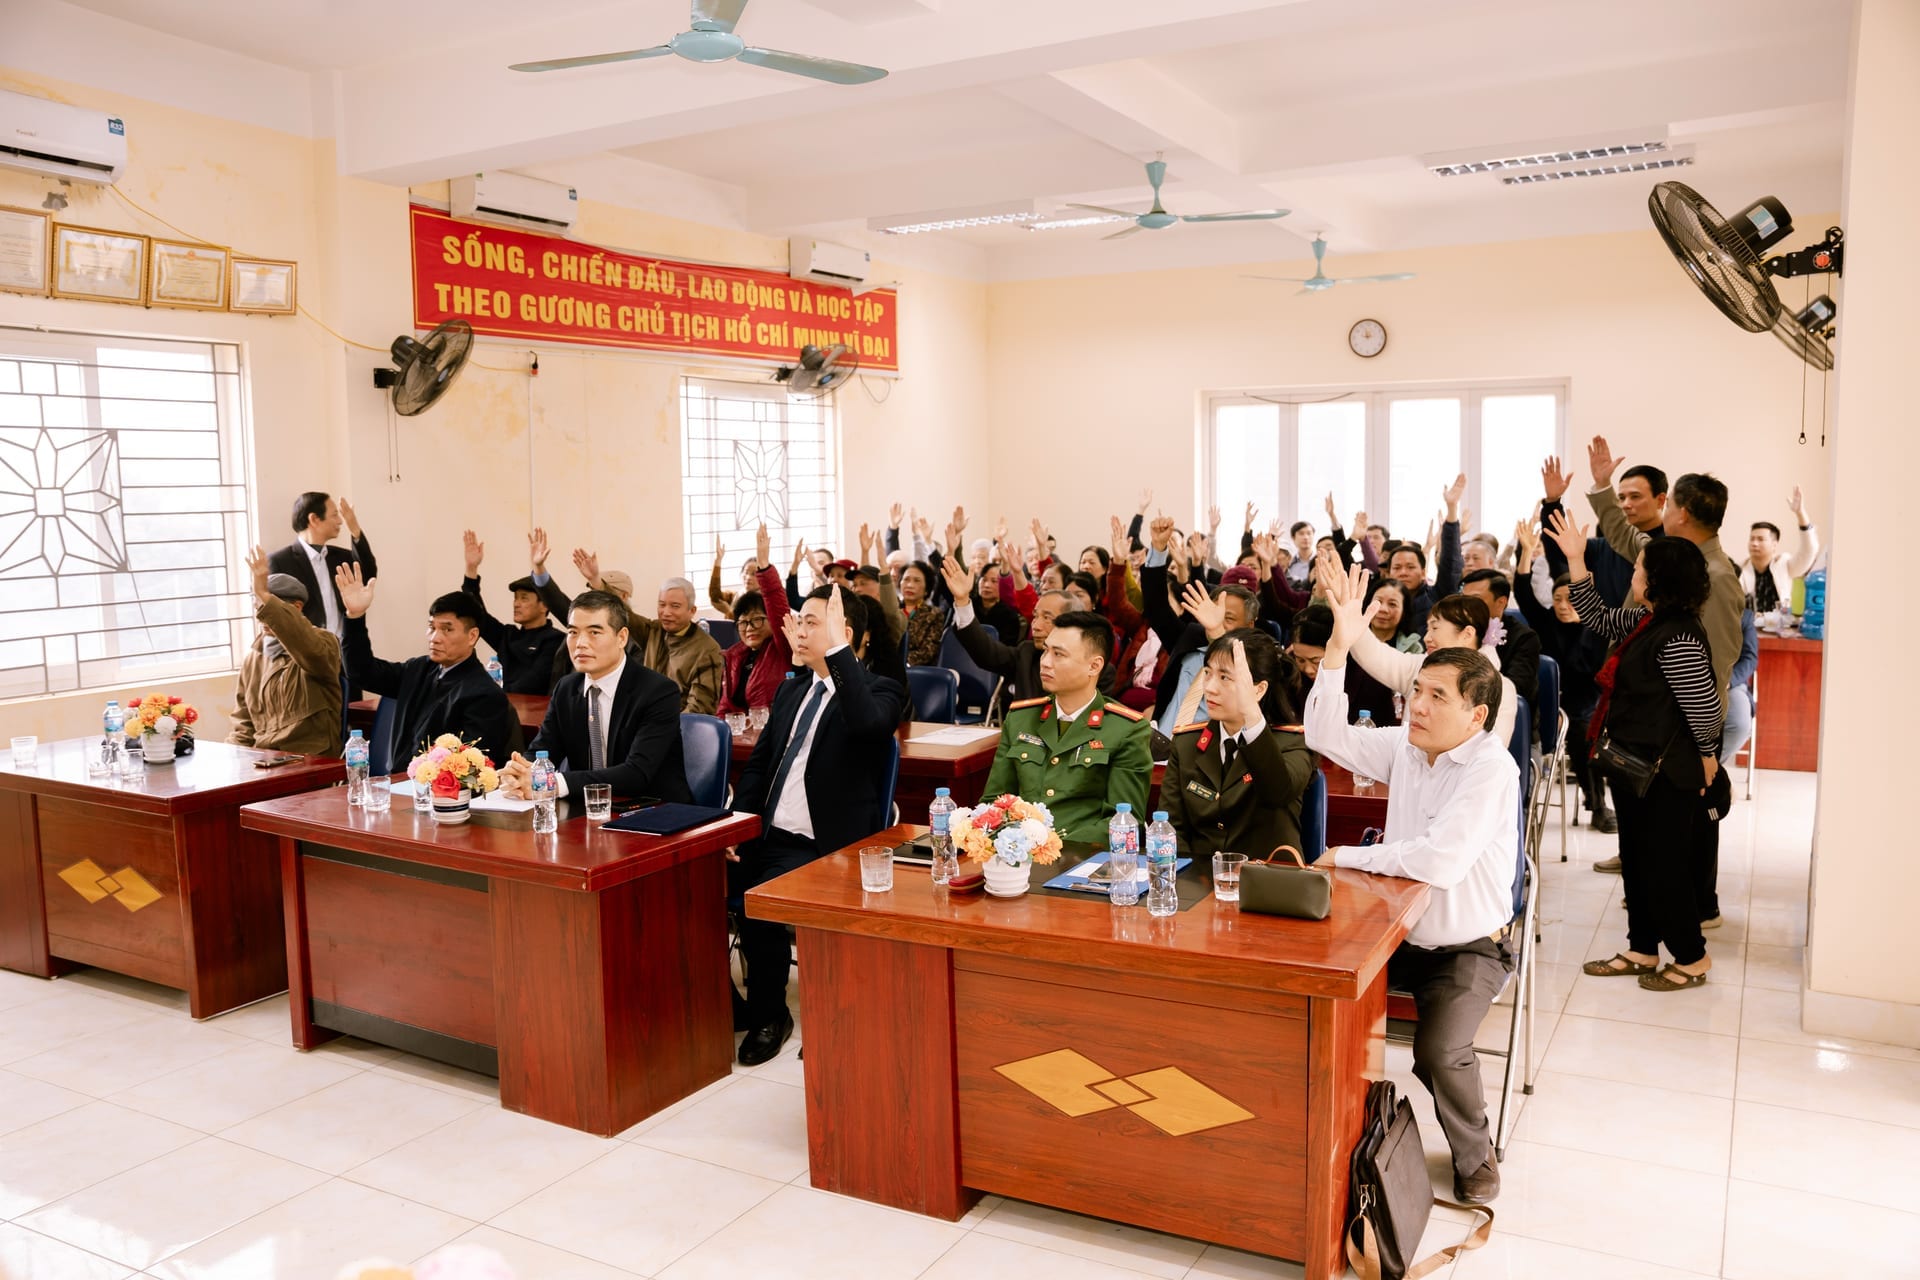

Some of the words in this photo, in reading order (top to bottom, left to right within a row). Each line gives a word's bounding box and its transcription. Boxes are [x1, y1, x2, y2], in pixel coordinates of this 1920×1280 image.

[442, 231, 533, 278] SỐNG,
[542, 252, 622, 287] CHIẾN
[628, 260, 682, 298] ĐẤU,
[688, 274, 727, 302] LAO
[731, 279, 785, 311] ĐỘNG
[789, 287, 813, 314] VÀ
[816, 294, 850, 322] HỌC
[854, 297, 884, 326] TẬP
[434, 283, 511, 318] THEO
[519, 294, 611, 329] GƯƠNG
[617, 301, 664, 335] CHỦ
[670, 311, 719, 342] TỊCH
[724, 312, 751, 343] HỒ
[755, 320, 788, 348] CHÍ
[792, 326, 840, 351] MINH
[843, 330, 860, 354] VĨ
[862, 335, 889, 361] ĐẠI
